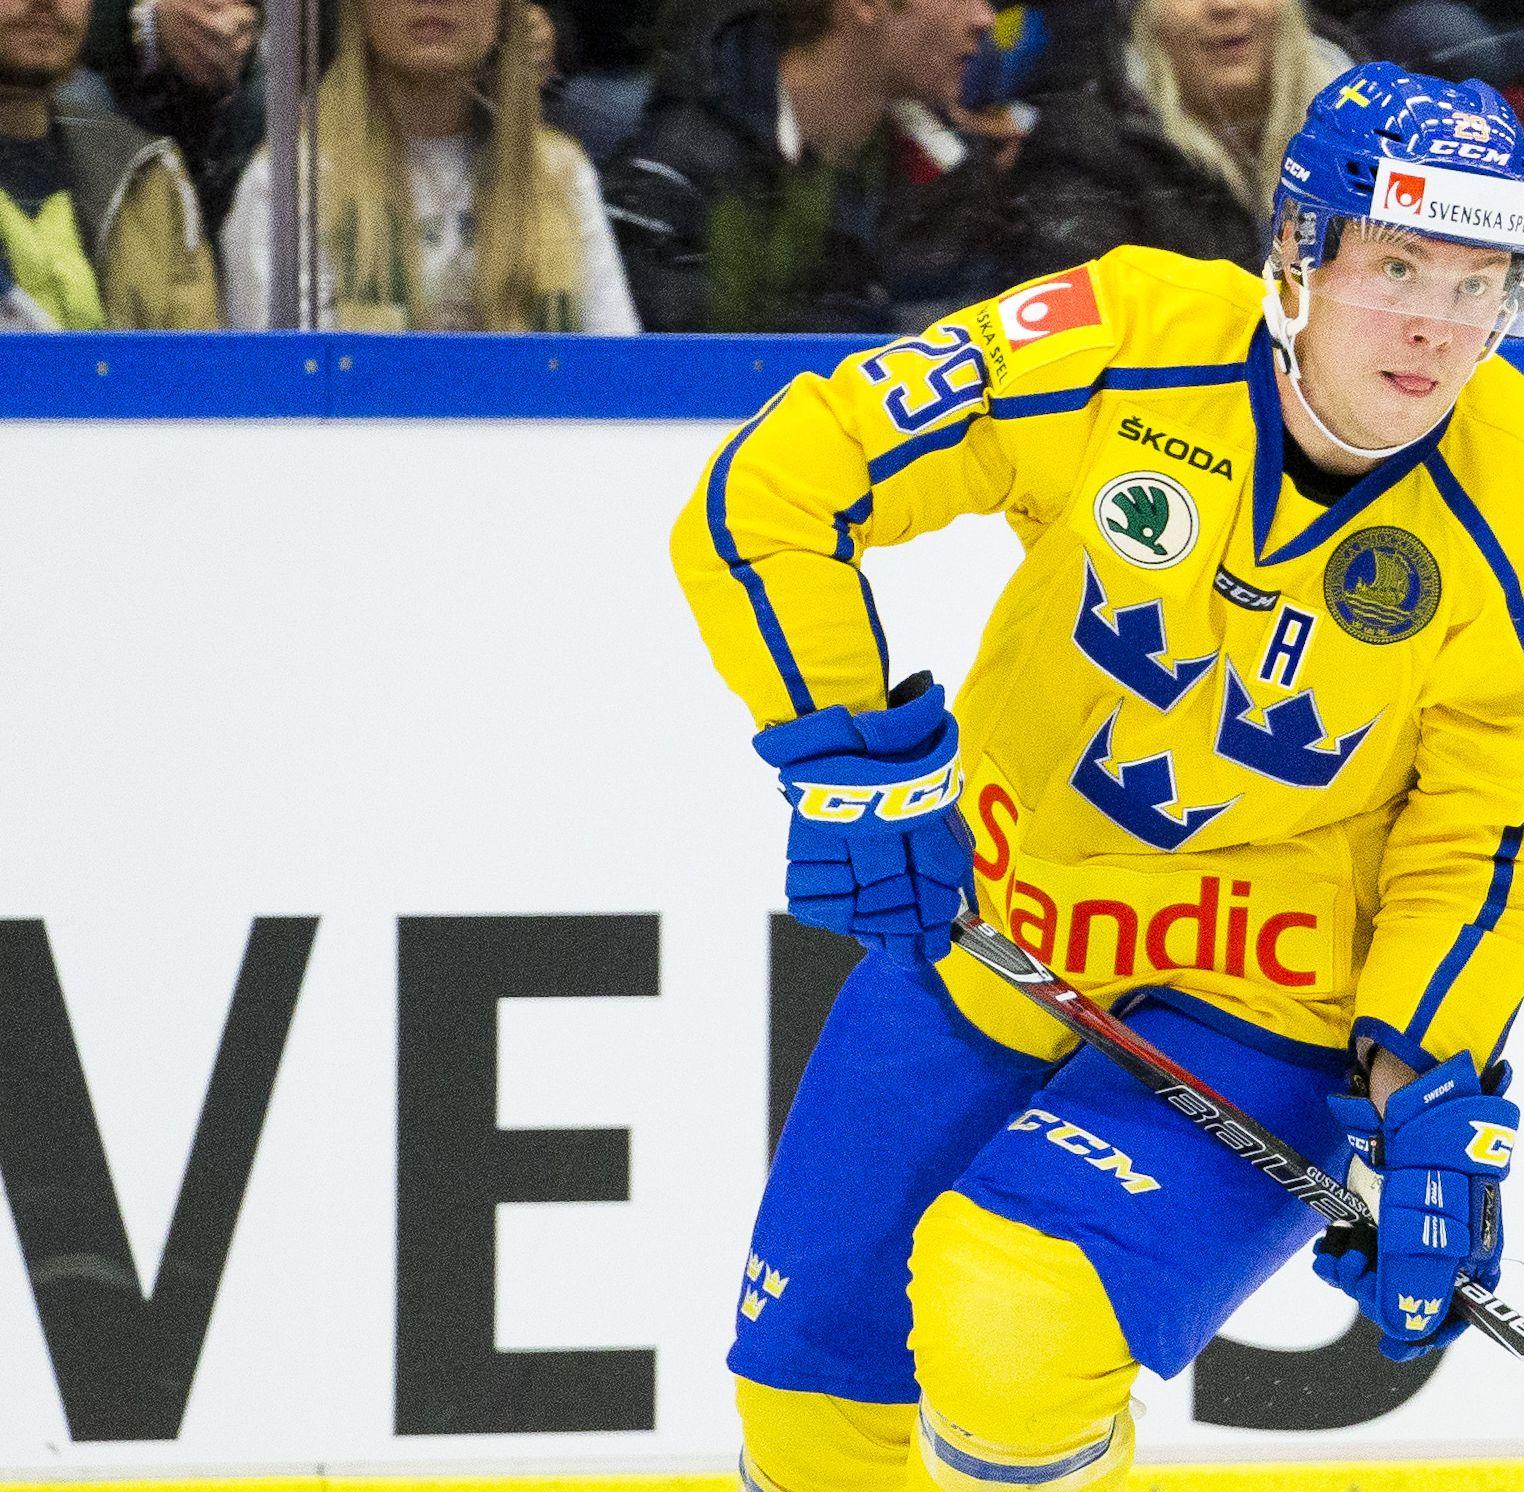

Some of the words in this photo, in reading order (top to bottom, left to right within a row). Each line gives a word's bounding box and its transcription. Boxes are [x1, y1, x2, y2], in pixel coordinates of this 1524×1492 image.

[1452, 112, 1491, 143] 29
[1284, 157, 1311, 182] CCM
[1429, 139, 1511, 166] CCM
[1428, 201, 1502, 229] SVENSKA
[860, 325, 989, 436] 29
[989, 346, 1009, 386] SPEL
[1117, 416, 1234, 481] ŠKODA
[1215, 571, 1277, 608] CCM
[1257, 604, 1318, 690] A
[973, 784, 1317, 987] Sandic
[1423, 1079, 1455, 1104] SWEDEN
[1007, 1108, 1162, 1195] CCM
[1306, 1166, 1373, 1221] GUSTAFSSO
